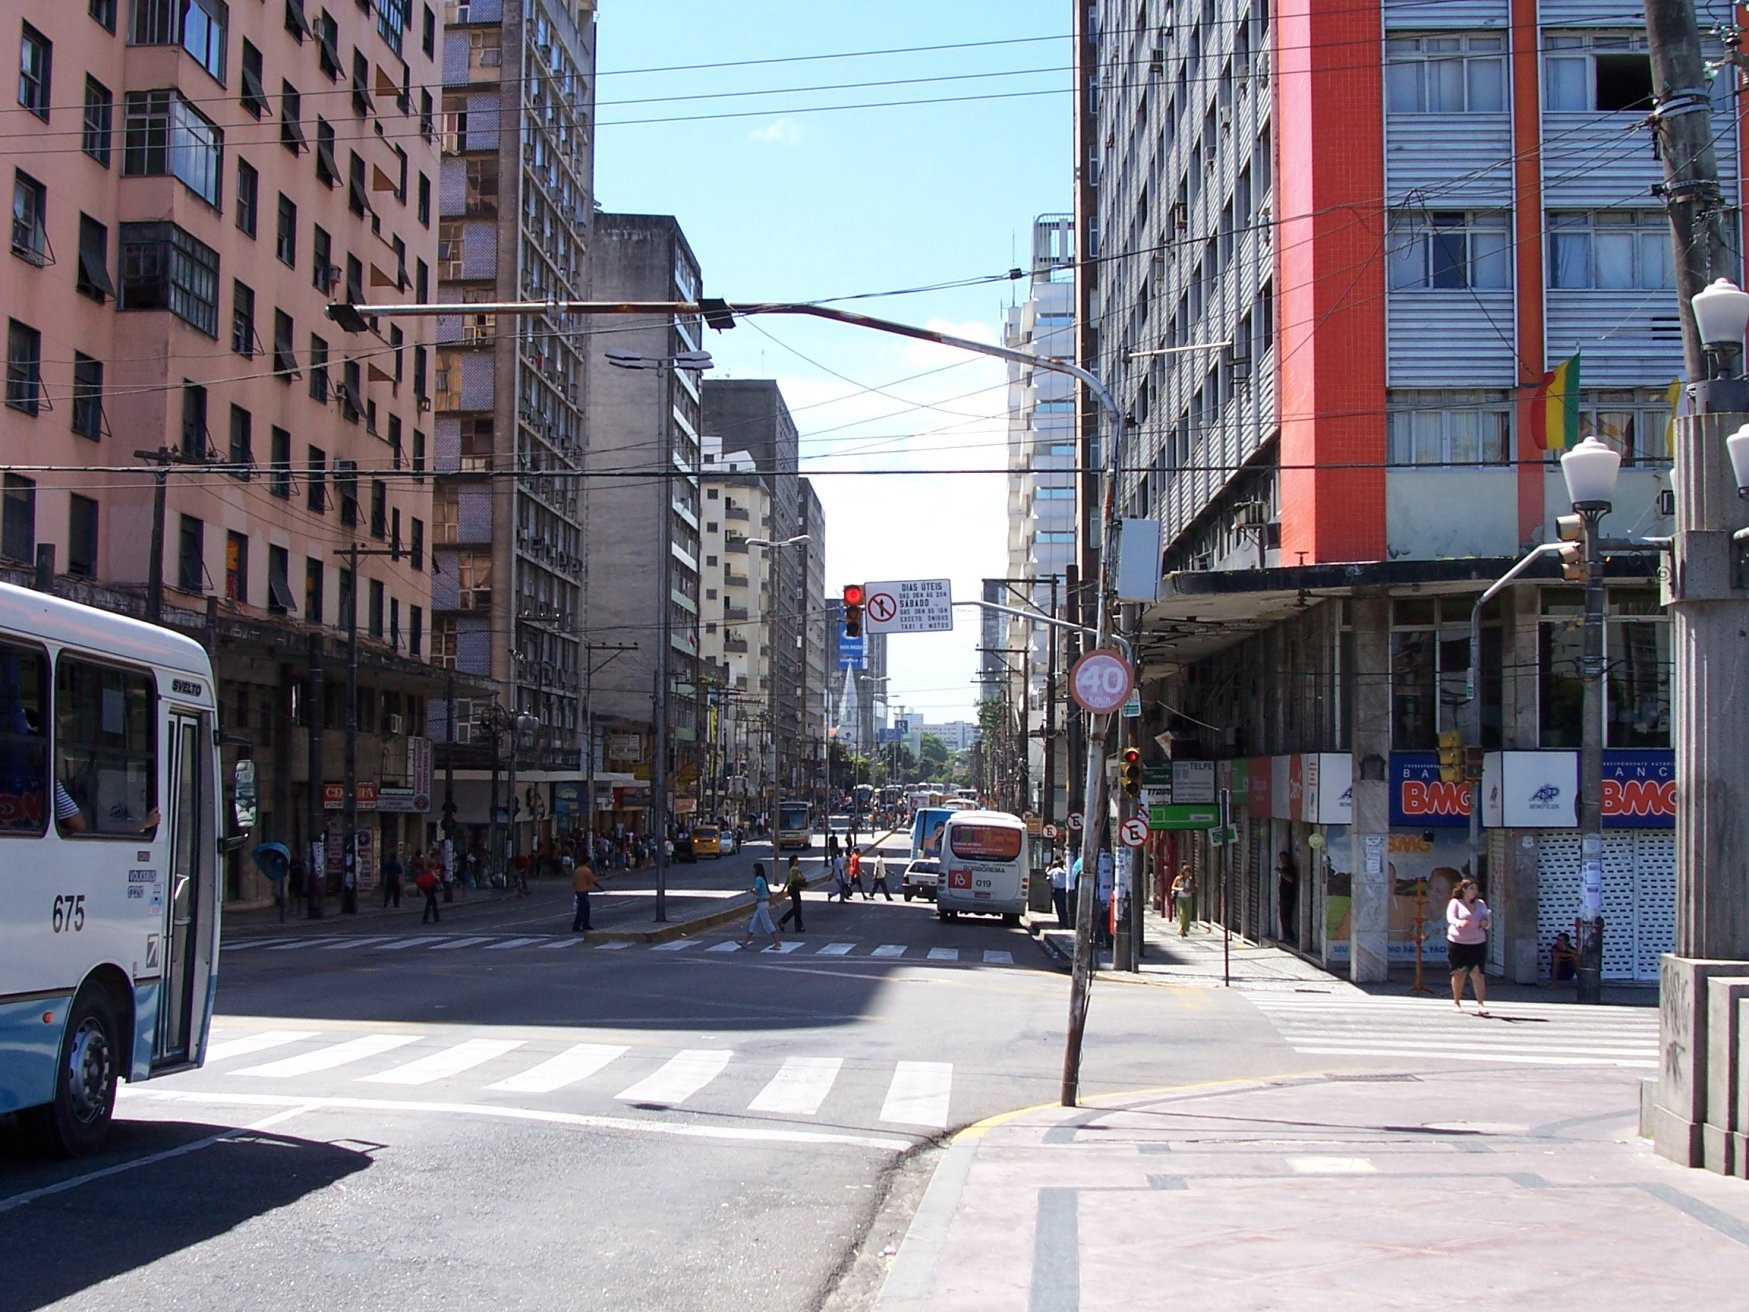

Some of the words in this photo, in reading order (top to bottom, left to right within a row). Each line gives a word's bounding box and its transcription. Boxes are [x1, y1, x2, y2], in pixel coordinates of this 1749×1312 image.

[901, 583, 918, 592] DIAS
[900, 615, 922, 623] EXCETO
[1078, 665, 1124, 694] 40
[172, 679, 202, 697] SVELTO
[1190, 762, 1213, 771] TELPE
[963, 865, 1006, 875] BORBOREMA
[975, 879, 992, 888] 019
[52, 894, 85, 934] 675
